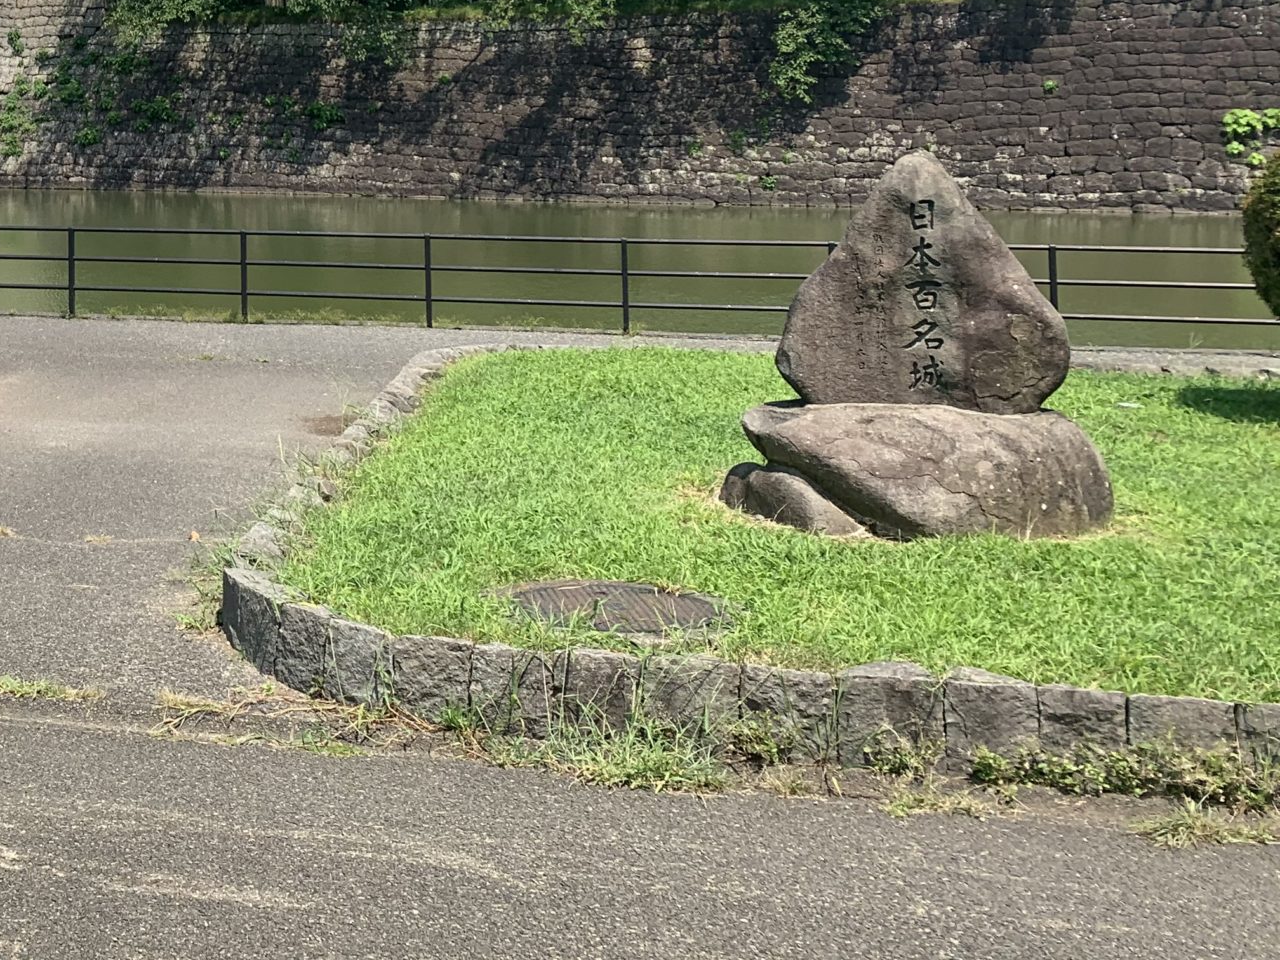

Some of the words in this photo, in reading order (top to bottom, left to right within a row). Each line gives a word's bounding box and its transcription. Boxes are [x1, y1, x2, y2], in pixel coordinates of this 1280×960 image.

[901, 199, 945, 390] 日本百名城
